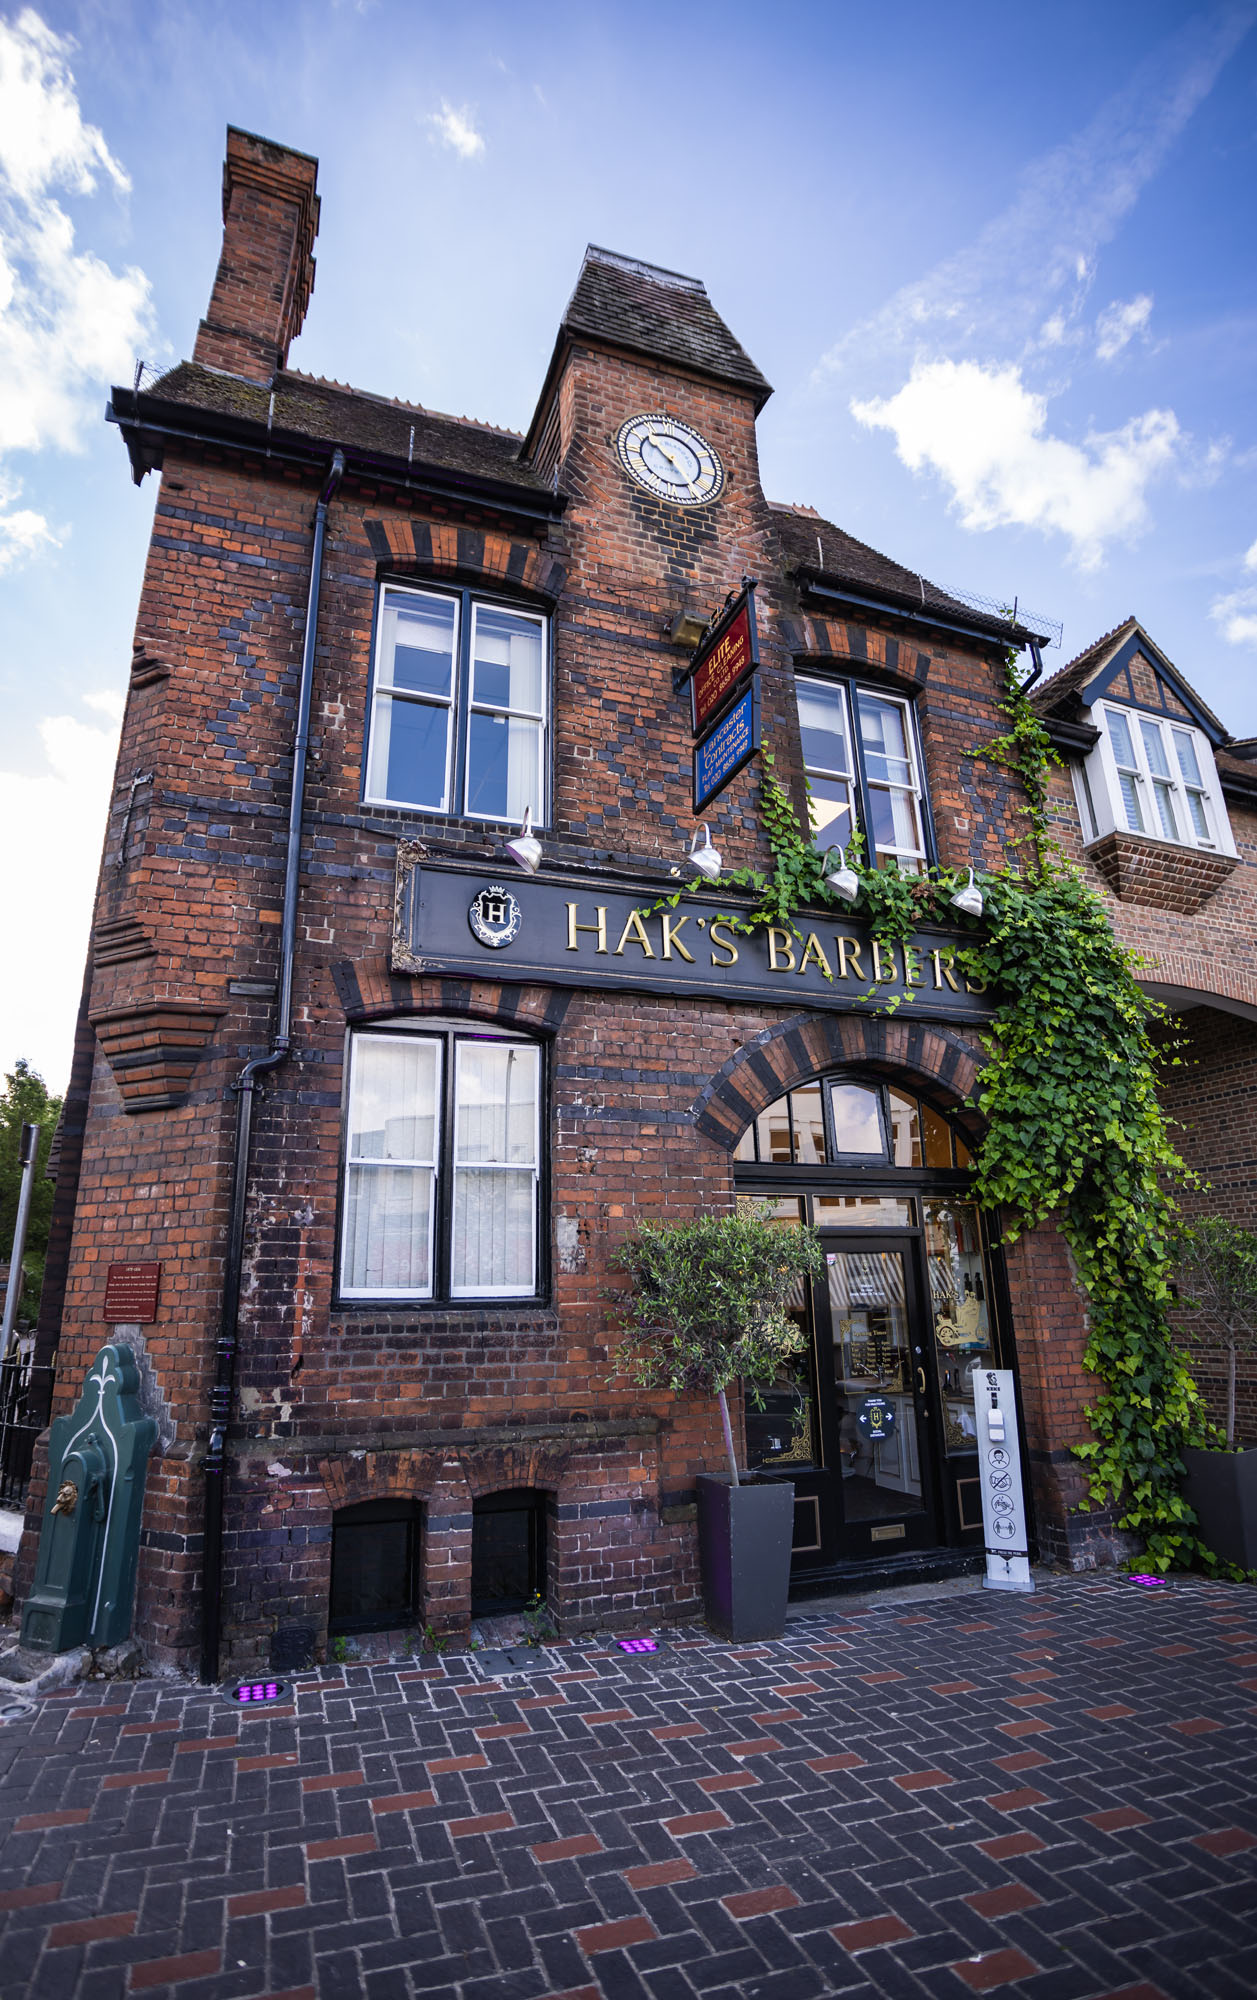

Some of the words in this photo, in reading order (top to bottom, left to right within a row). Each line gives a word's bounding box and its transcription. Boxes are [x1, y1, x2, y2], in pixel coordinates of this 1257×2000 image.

[698, 672, 715, 699] OFFICE
[716, 635, 744, 674] CLEANING
[708, 636, 731, 675] ELITE
[702, 766, 714, 784] FLAT
[715, 726, 749, 769] MAINTENANCE
[703, 702, 747, 759] Lancaster
[704, 719, 744, 769] Contracts
[486, 902, 507, 925] H
[565, 902, 740, 968] HAK'S
